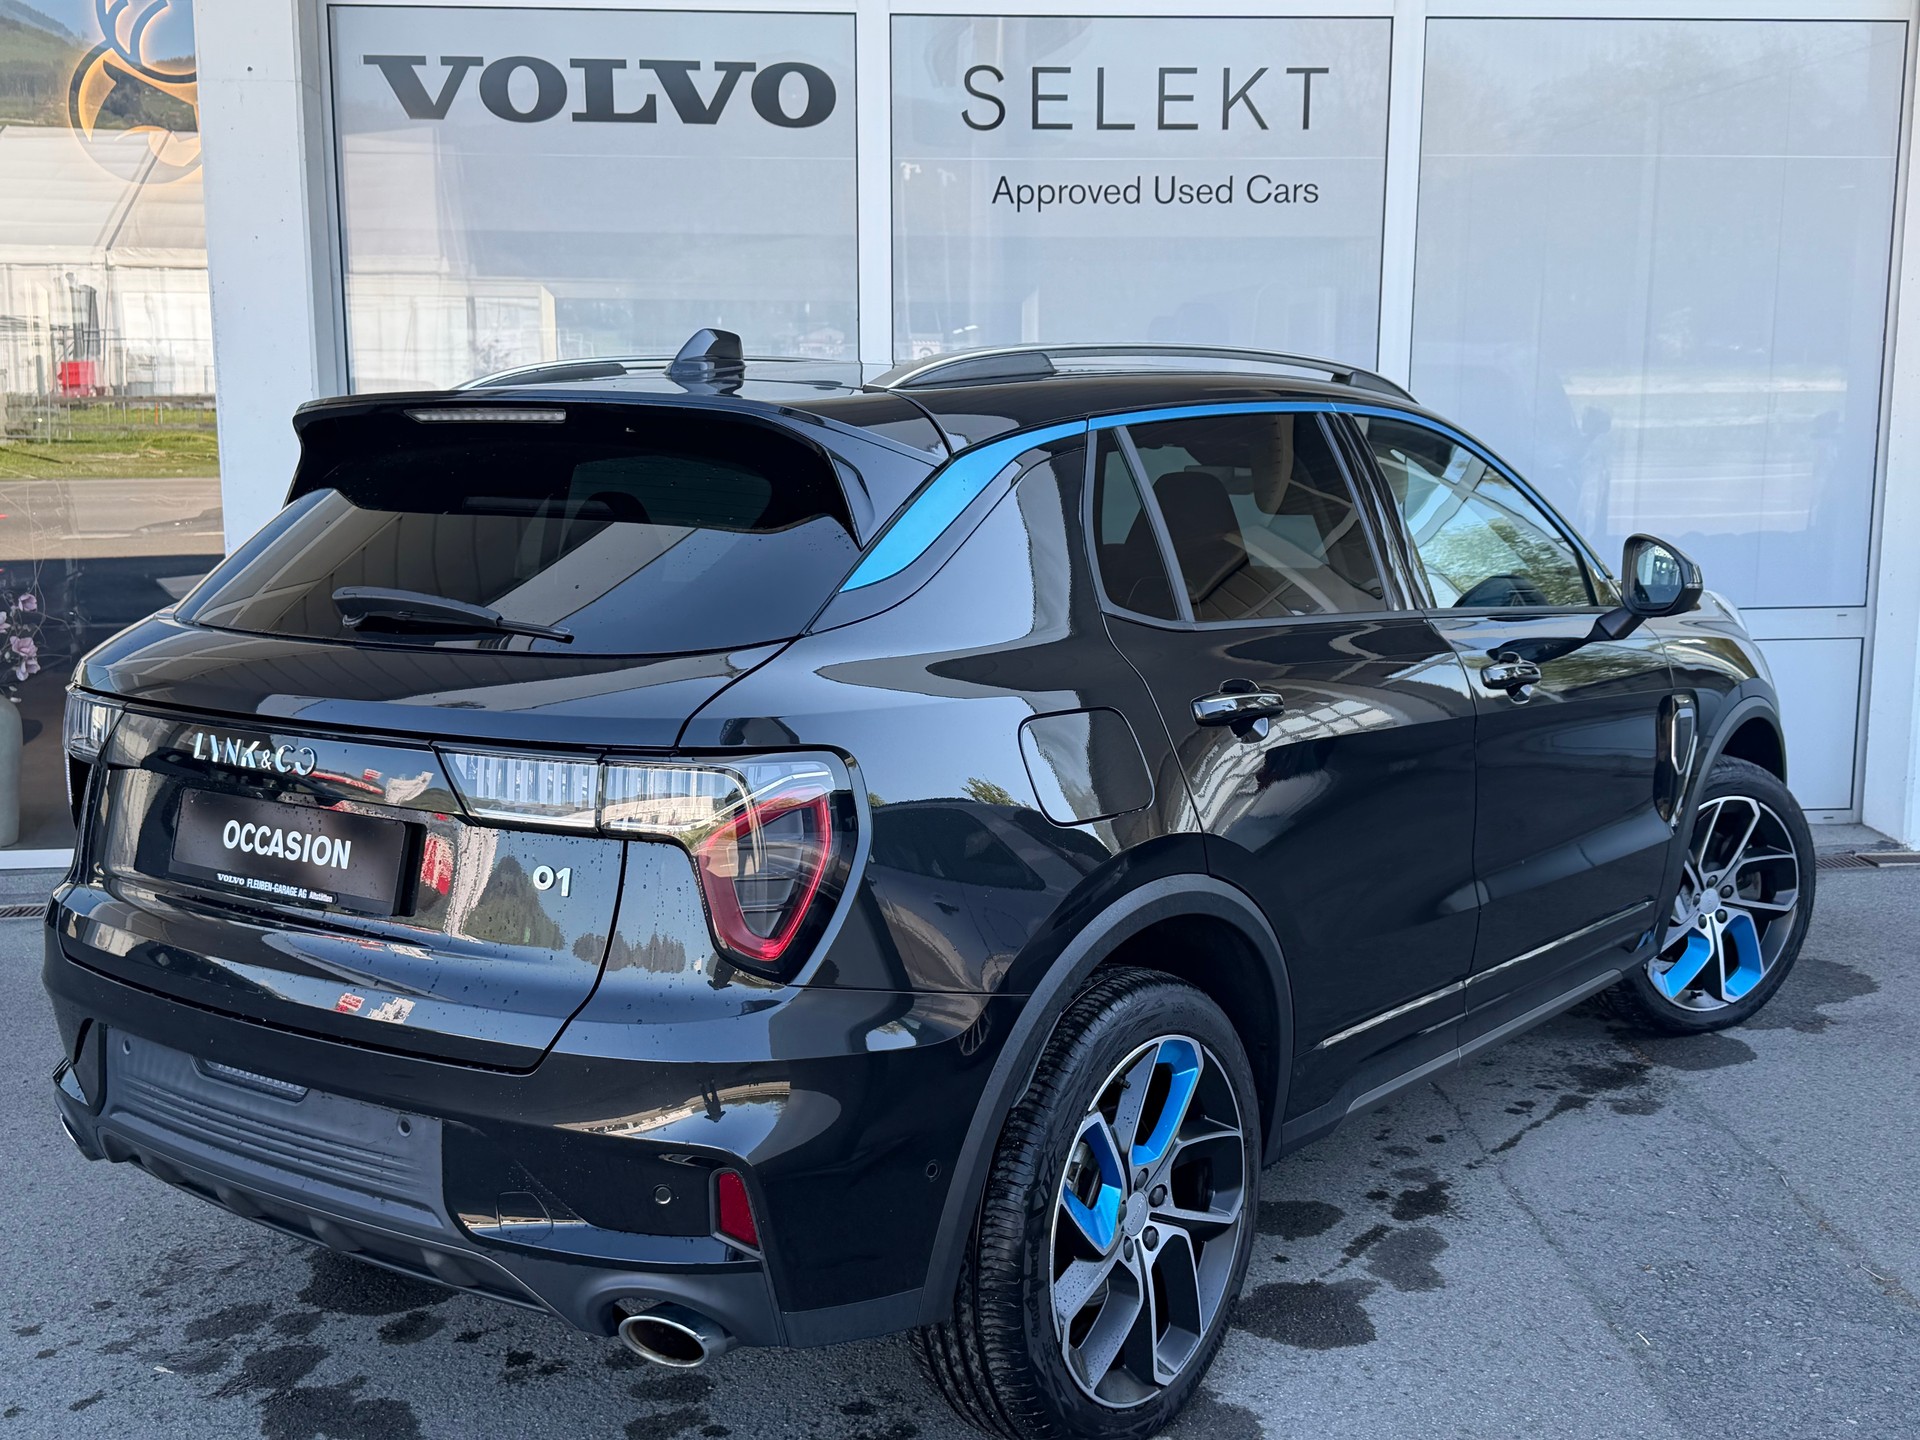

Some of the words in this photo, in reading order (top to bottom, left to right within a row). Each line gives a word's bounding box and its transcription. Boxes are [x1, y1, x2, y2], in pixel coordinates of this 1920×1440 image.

[363, 54, 837, 129] VOLVO
[961, 64, 1330, 131] SELEKT
[991, 175, 1141, 213] Approved
[1153, 175, 1234, 205] Used
[1245, 174, 1320, 205] Cars
[223, 820, 352, 870] OCCASION
[217, 873, 245, 886] VOLVO
[298, 888, 308, 899] AG
